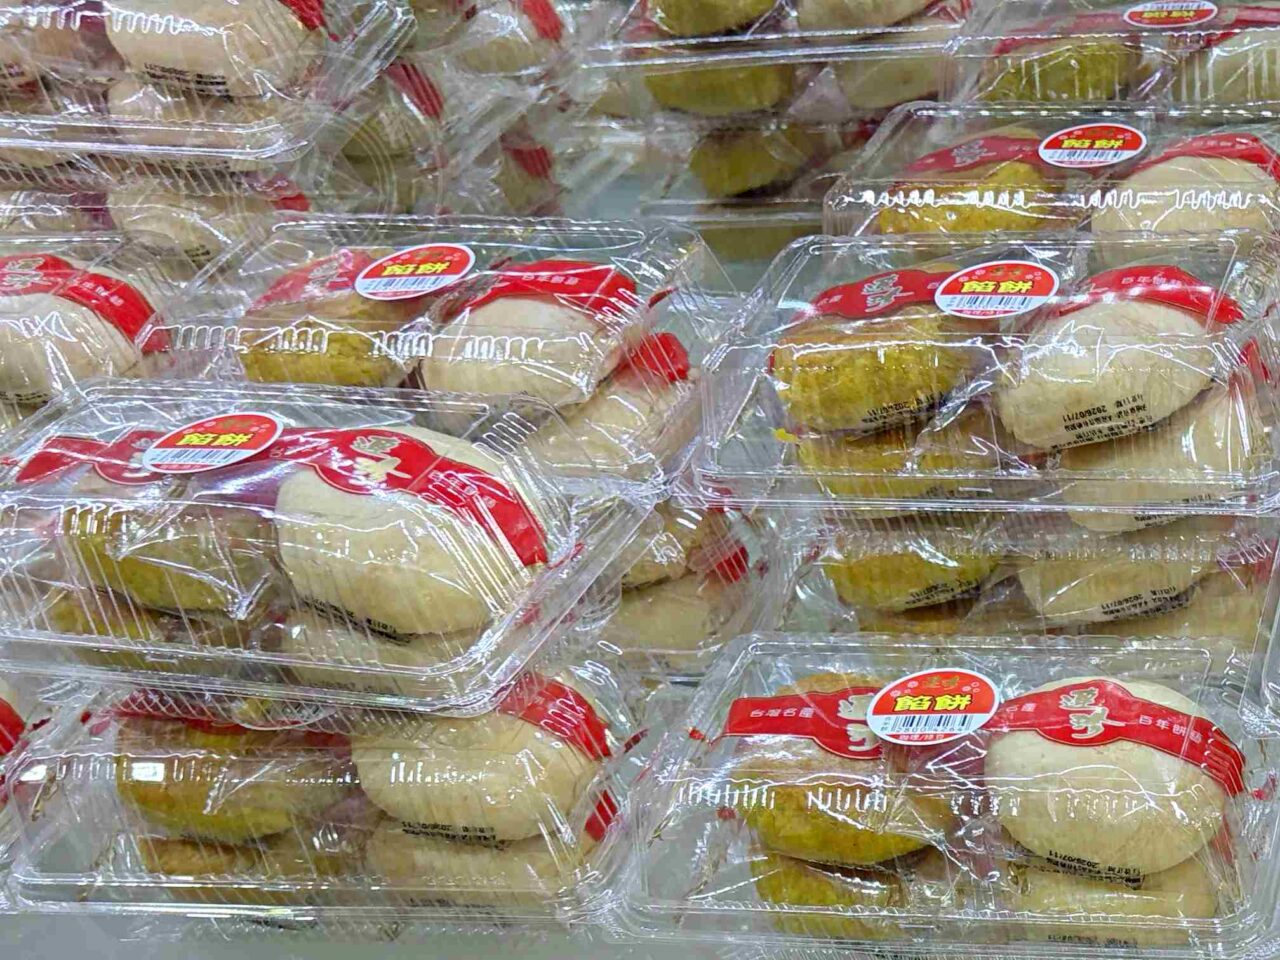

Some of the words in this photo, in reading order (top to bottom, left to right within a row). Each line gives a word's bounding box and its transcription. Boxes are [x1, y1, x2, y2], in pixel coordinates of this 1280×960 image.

[961, 280, 1034, 294] 餡餅
[175, 432, 254, 447] 餡餅
[893, 693, 972, 712] 餡餅
